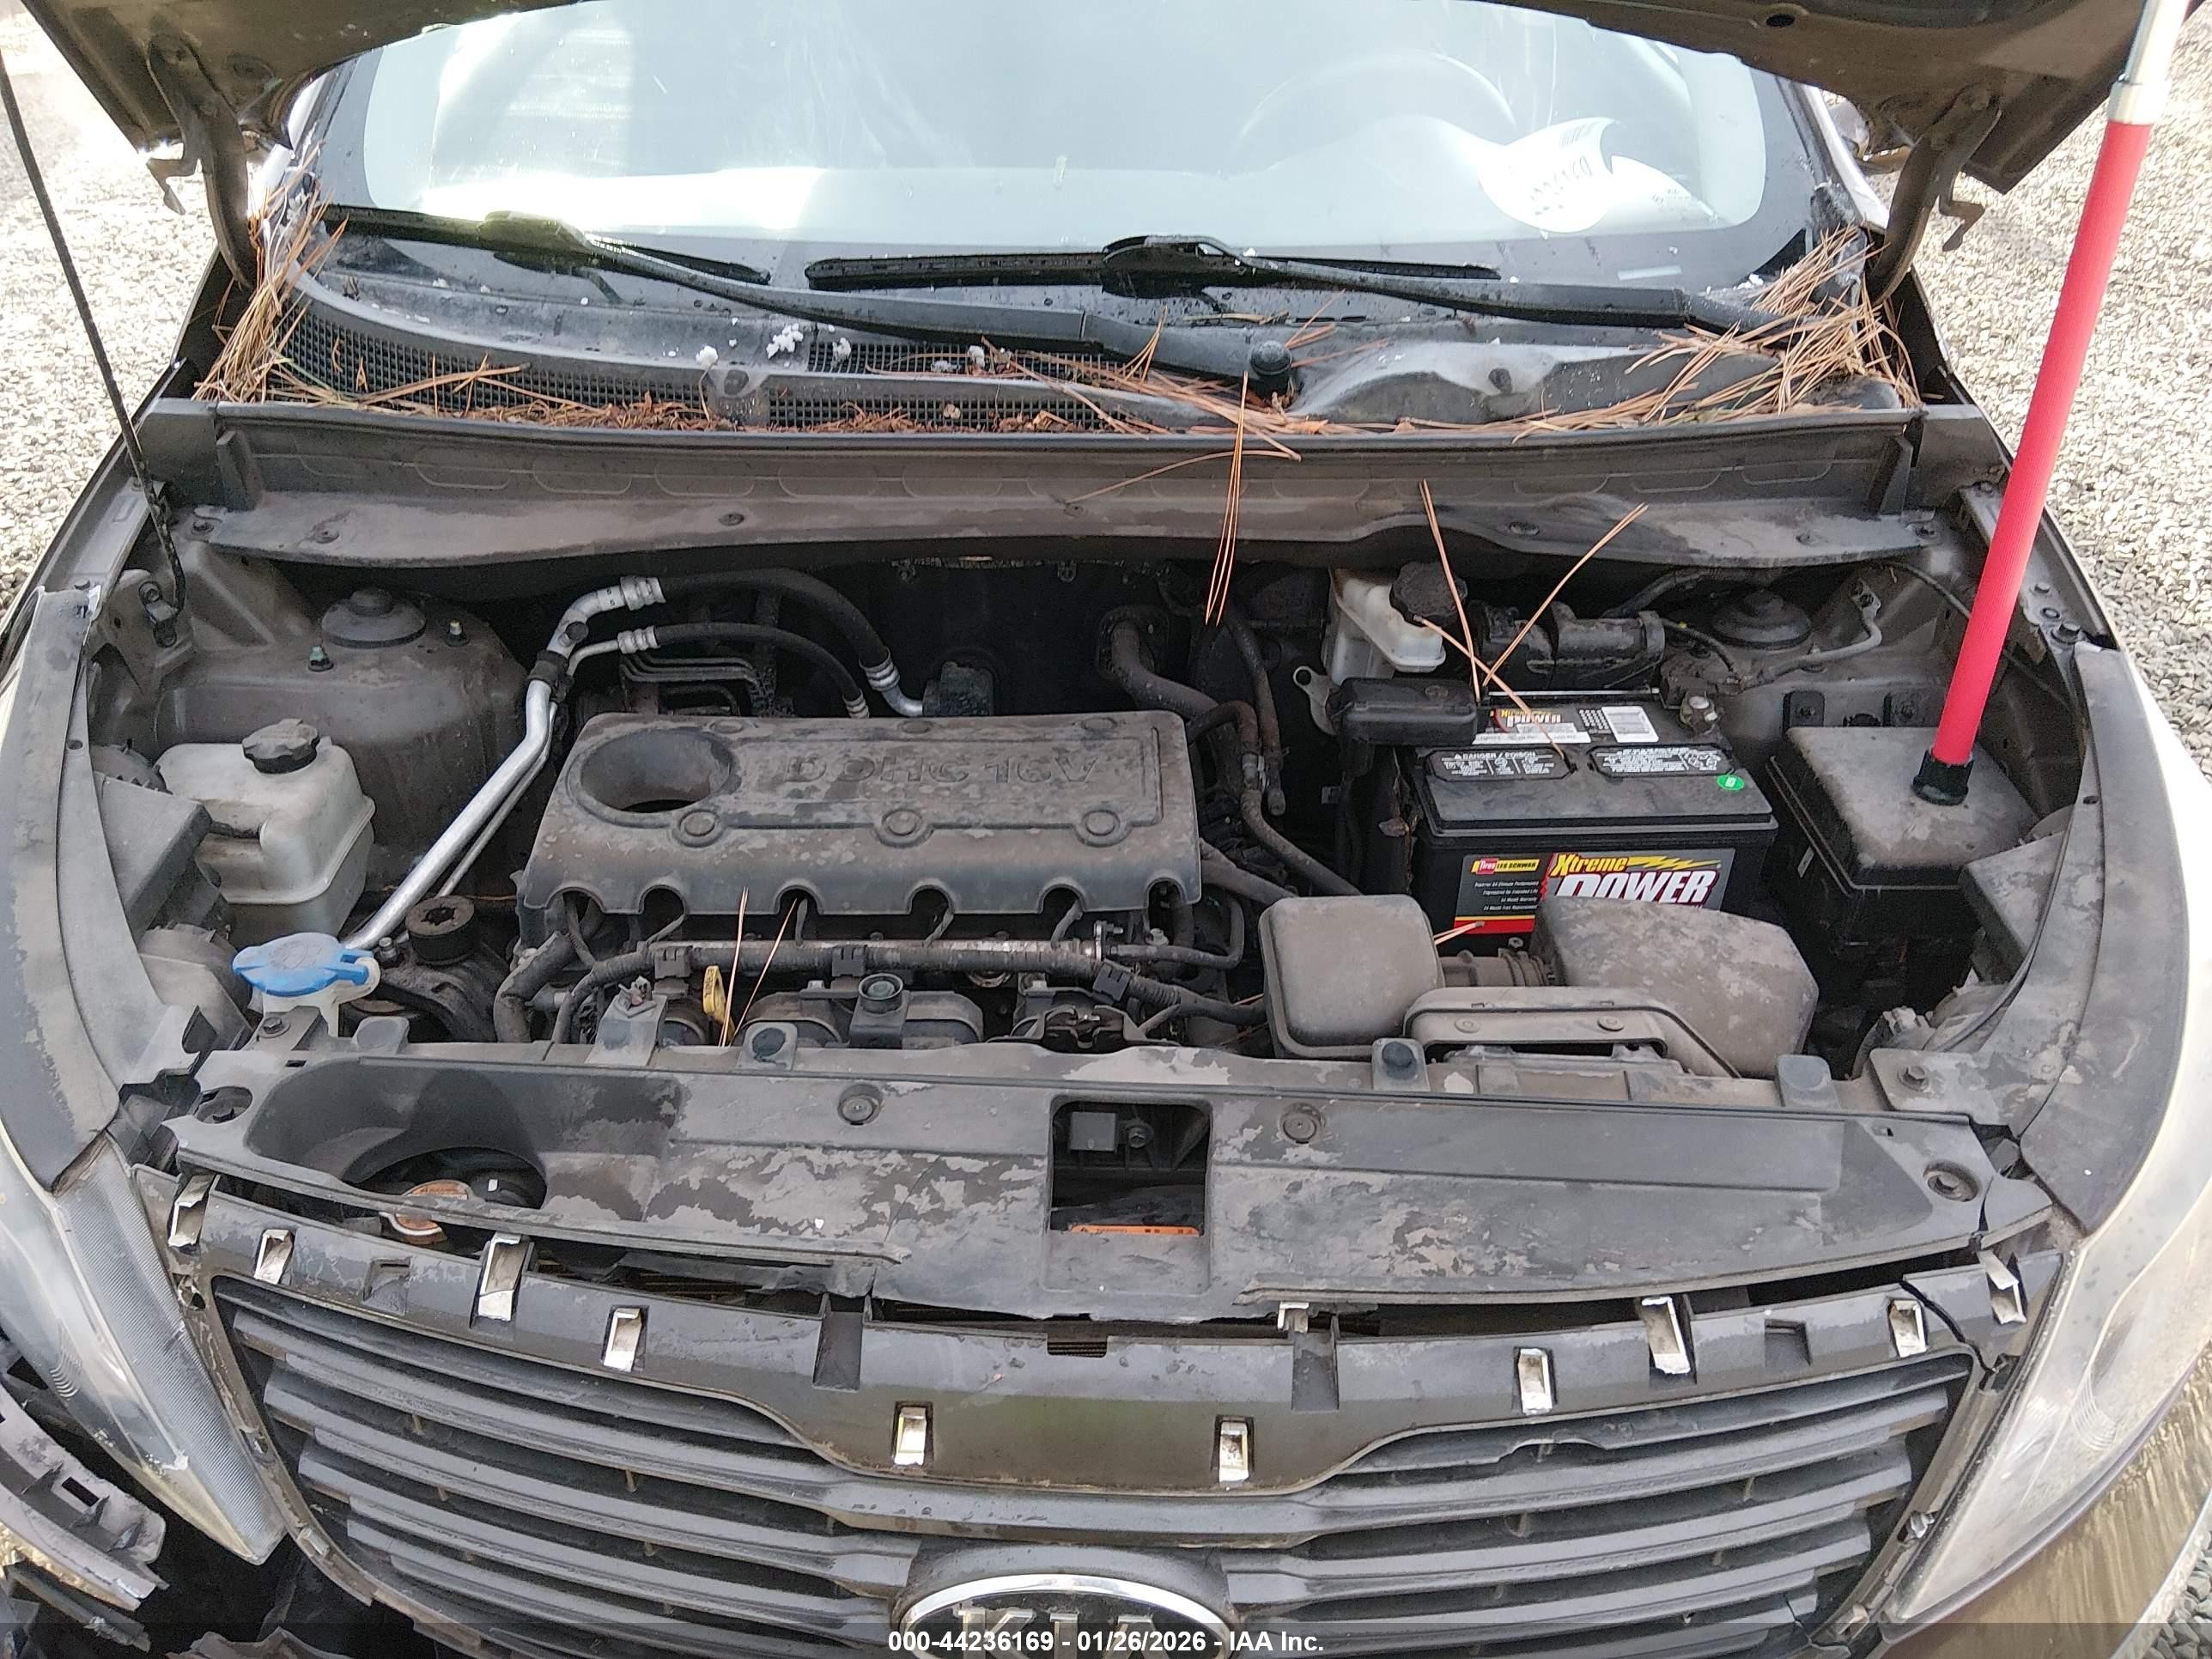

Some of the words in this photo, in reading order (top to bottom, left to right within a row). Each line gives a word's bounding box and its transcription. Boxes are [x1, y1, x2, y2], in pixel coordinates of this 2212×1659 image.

[785, 756, 969, 783] DOHC
[985, 756, 1099, 784] 16V
[1550, 854, 1629, 877] Xtreme
[1556, 870, 1717, 904] POWER
[957, 1608, 1171, 1659] KIA
